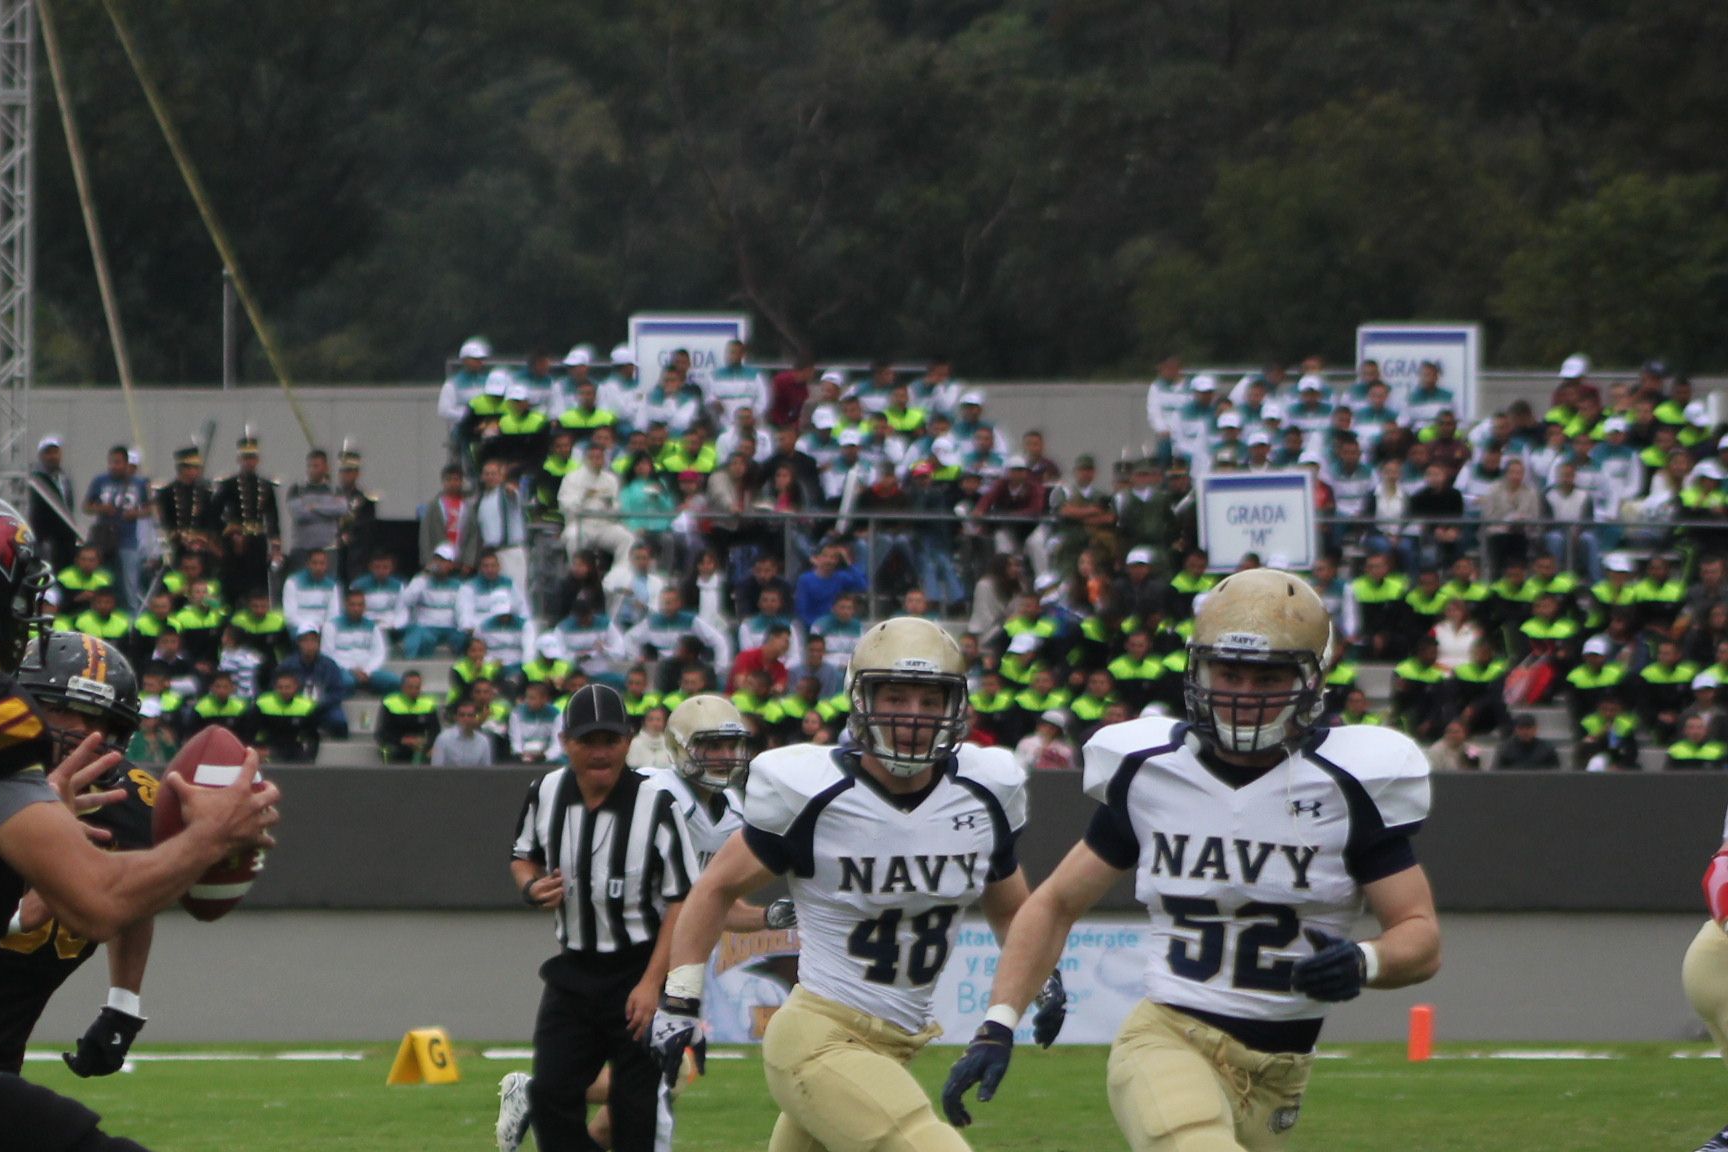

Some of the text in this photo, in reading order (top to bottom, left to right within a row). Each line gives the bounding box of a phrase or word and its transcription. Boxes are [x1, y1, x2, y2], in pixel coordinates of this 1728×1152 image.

[1226, 504, 1286, 525] GRADA
[1232, 633, 1259, 646] NAVY
[838, 852, 978, 894] NAVY
[1151, 831, 1320, 891] NAVY
[609, 879, 624, 898] U
[848, 904, 960, 986] 48
[1161, 895, 1300, 993] 52
[428, 1038, 447, 1069] G
